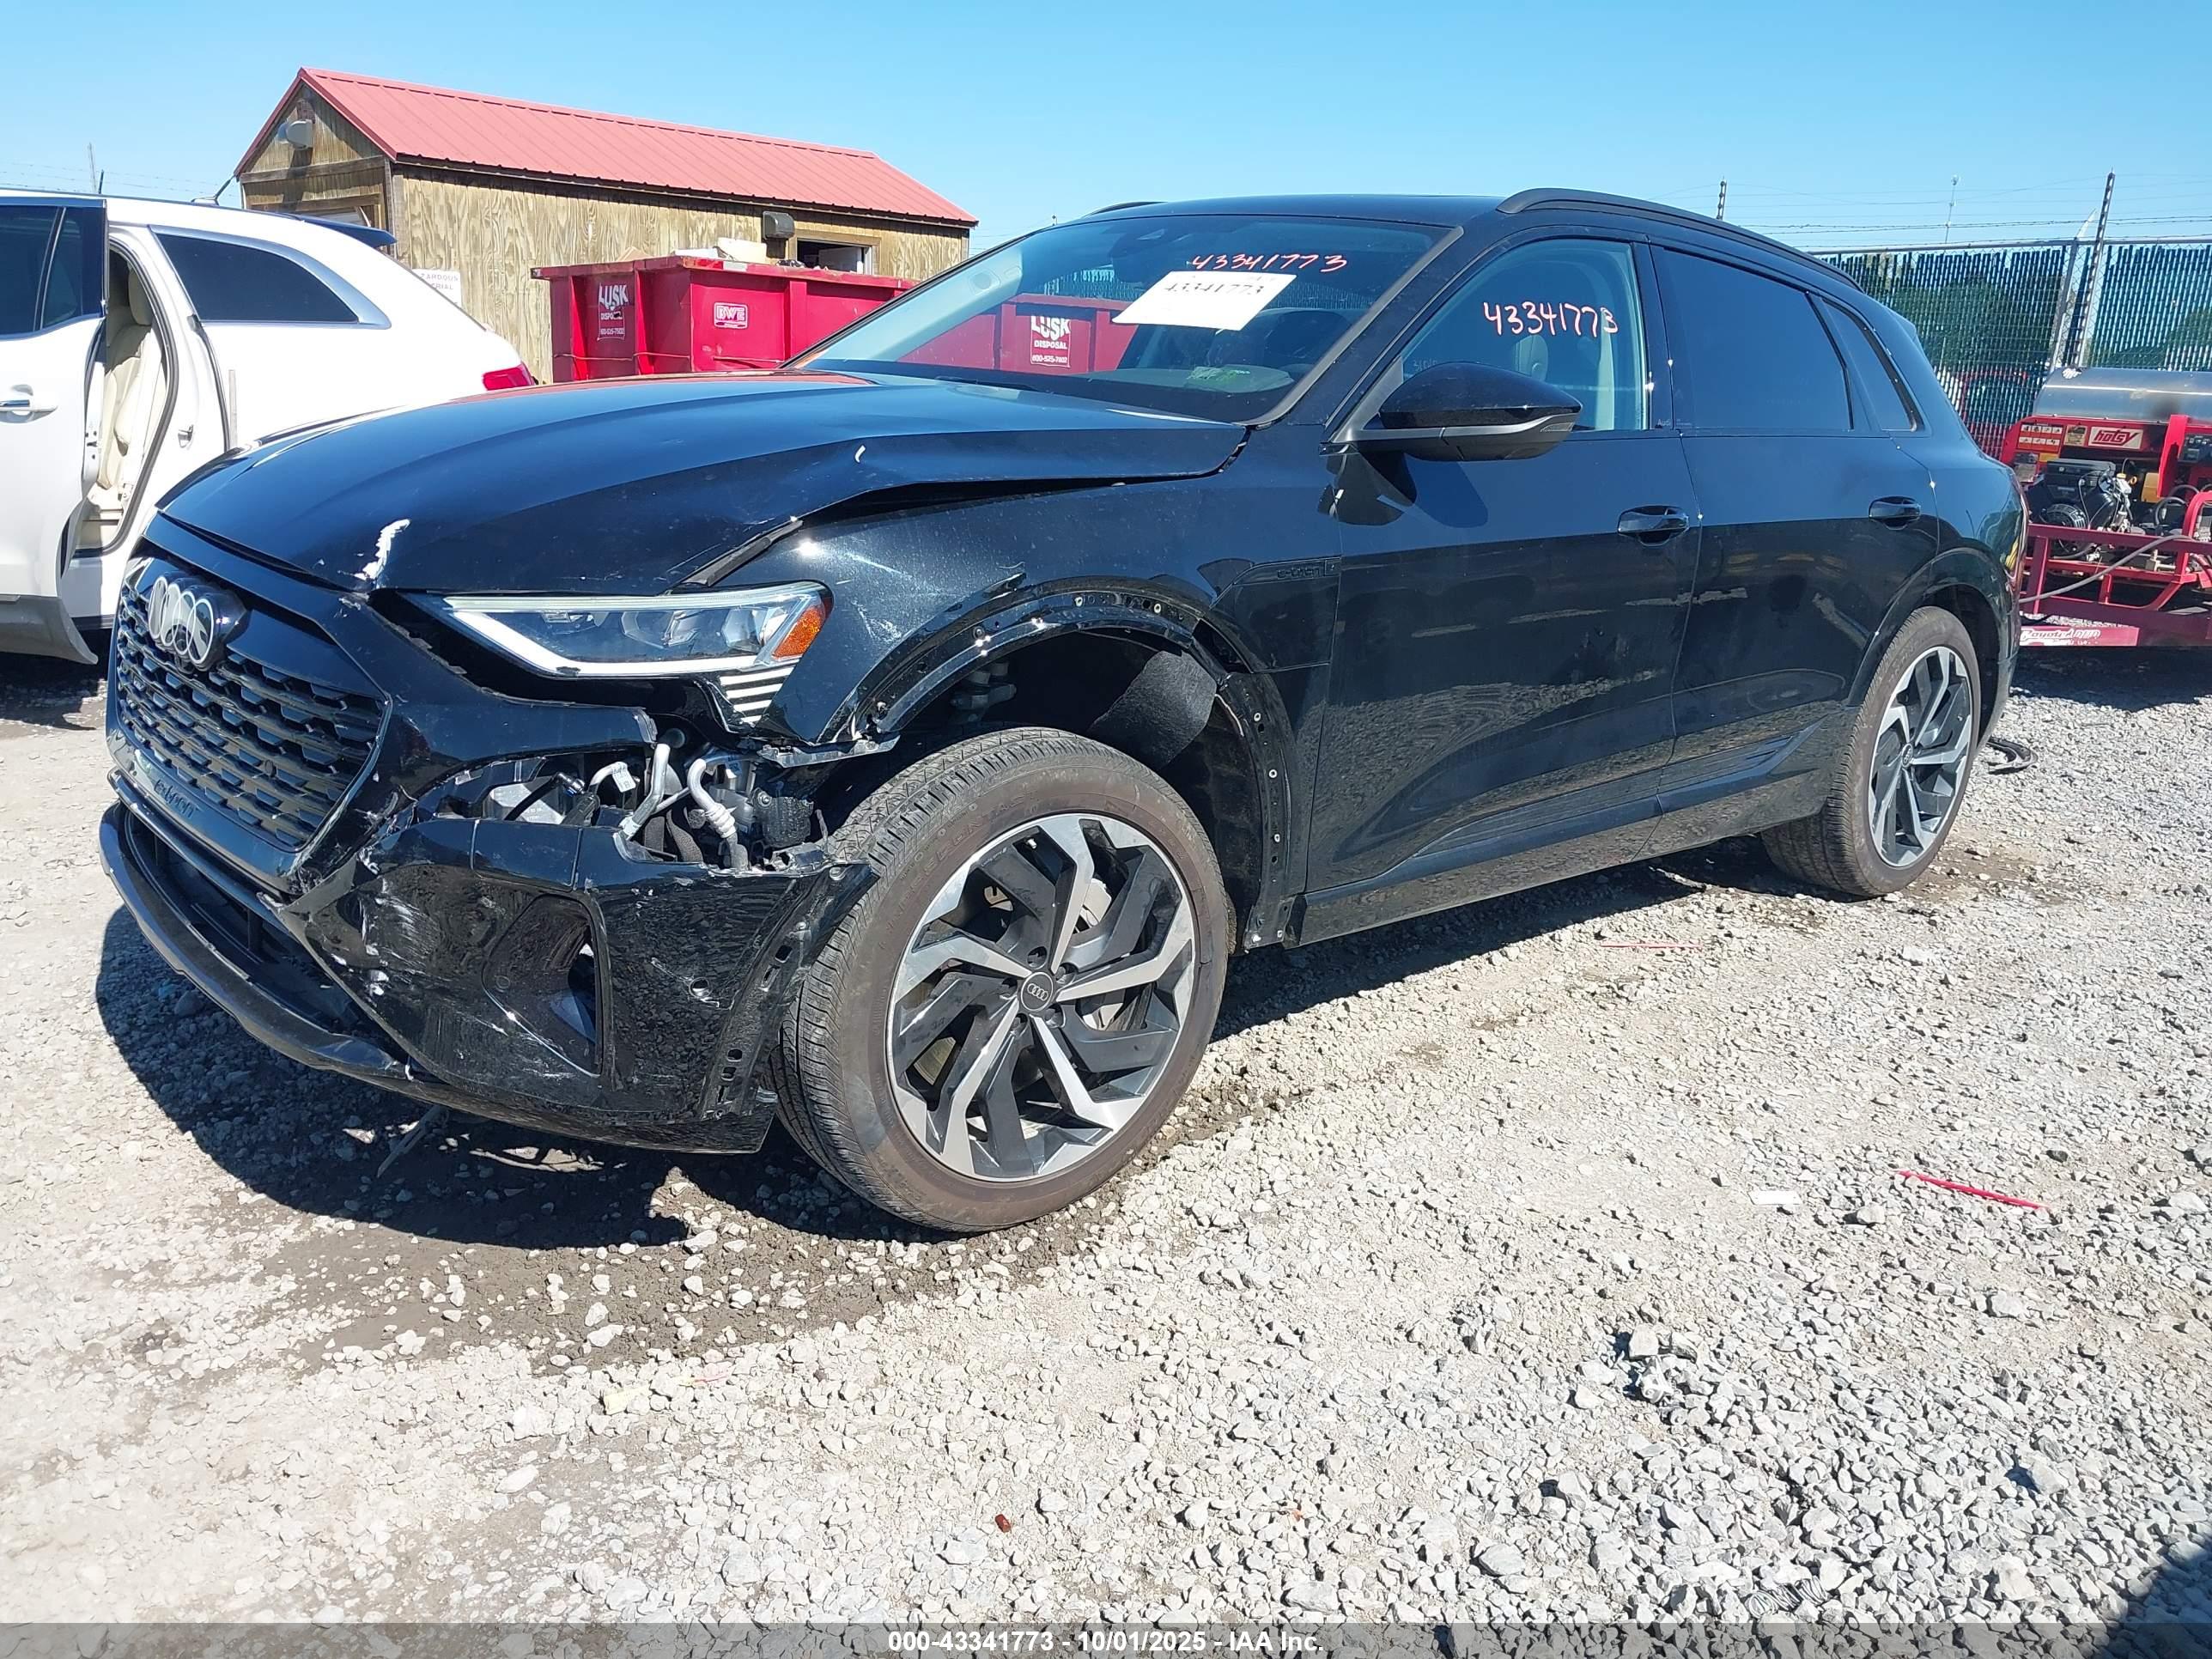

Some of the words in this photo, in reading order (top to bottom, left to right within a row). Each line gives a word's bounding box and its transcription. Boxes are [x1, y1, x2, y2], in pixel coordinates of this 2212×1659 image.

[1192, 254, 1347, 272] 43341773
[599, 284, 629, 311] LUSK
[1031, 315, 1072, 341] LUSK
[1484, 301, 1619, 337] 43341773
[1034, 340, 1067, 349] DISPOSAL
